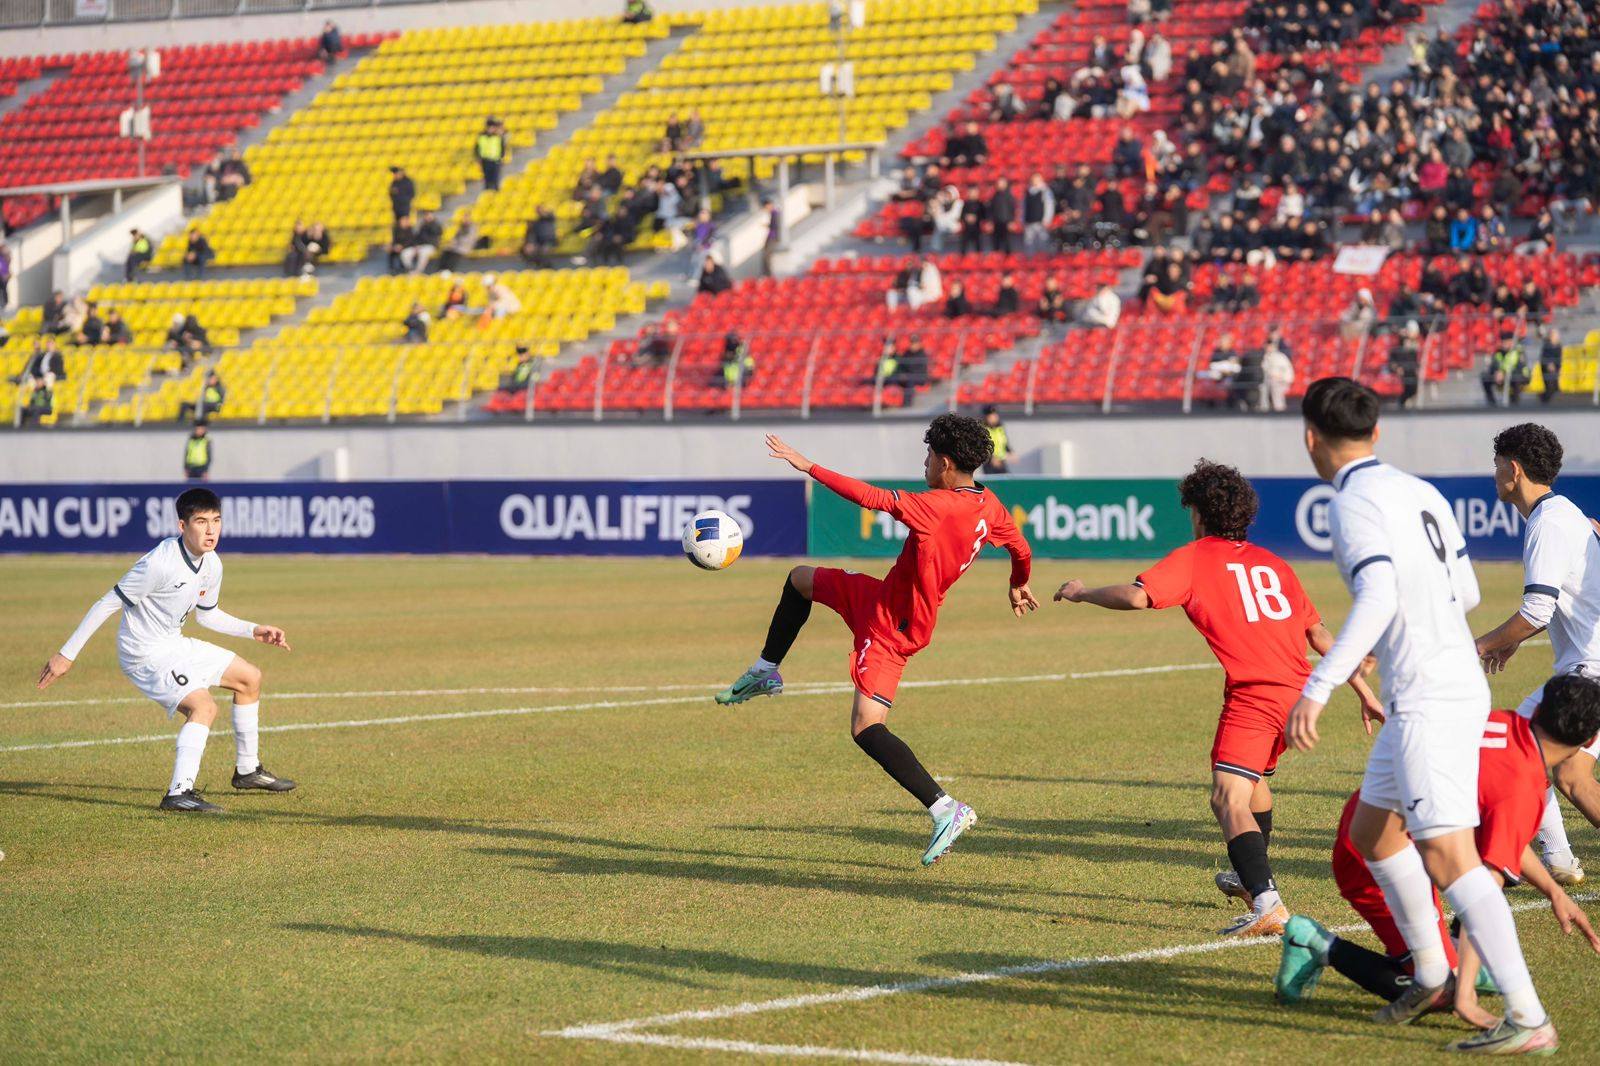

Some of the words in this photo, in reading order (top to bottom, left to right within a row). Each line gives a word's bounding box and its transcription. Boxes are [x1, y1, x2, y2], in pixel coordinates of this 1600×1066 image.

[54, 496, 131, 538] CUP
[221, 496, 304, 538] ARABIA
[308, 495, 375, 538] 2026
[960, 518, 988, 572] 3
[1225, 562, 1292, 622] 18
[171, 669, 188, 686] 6
